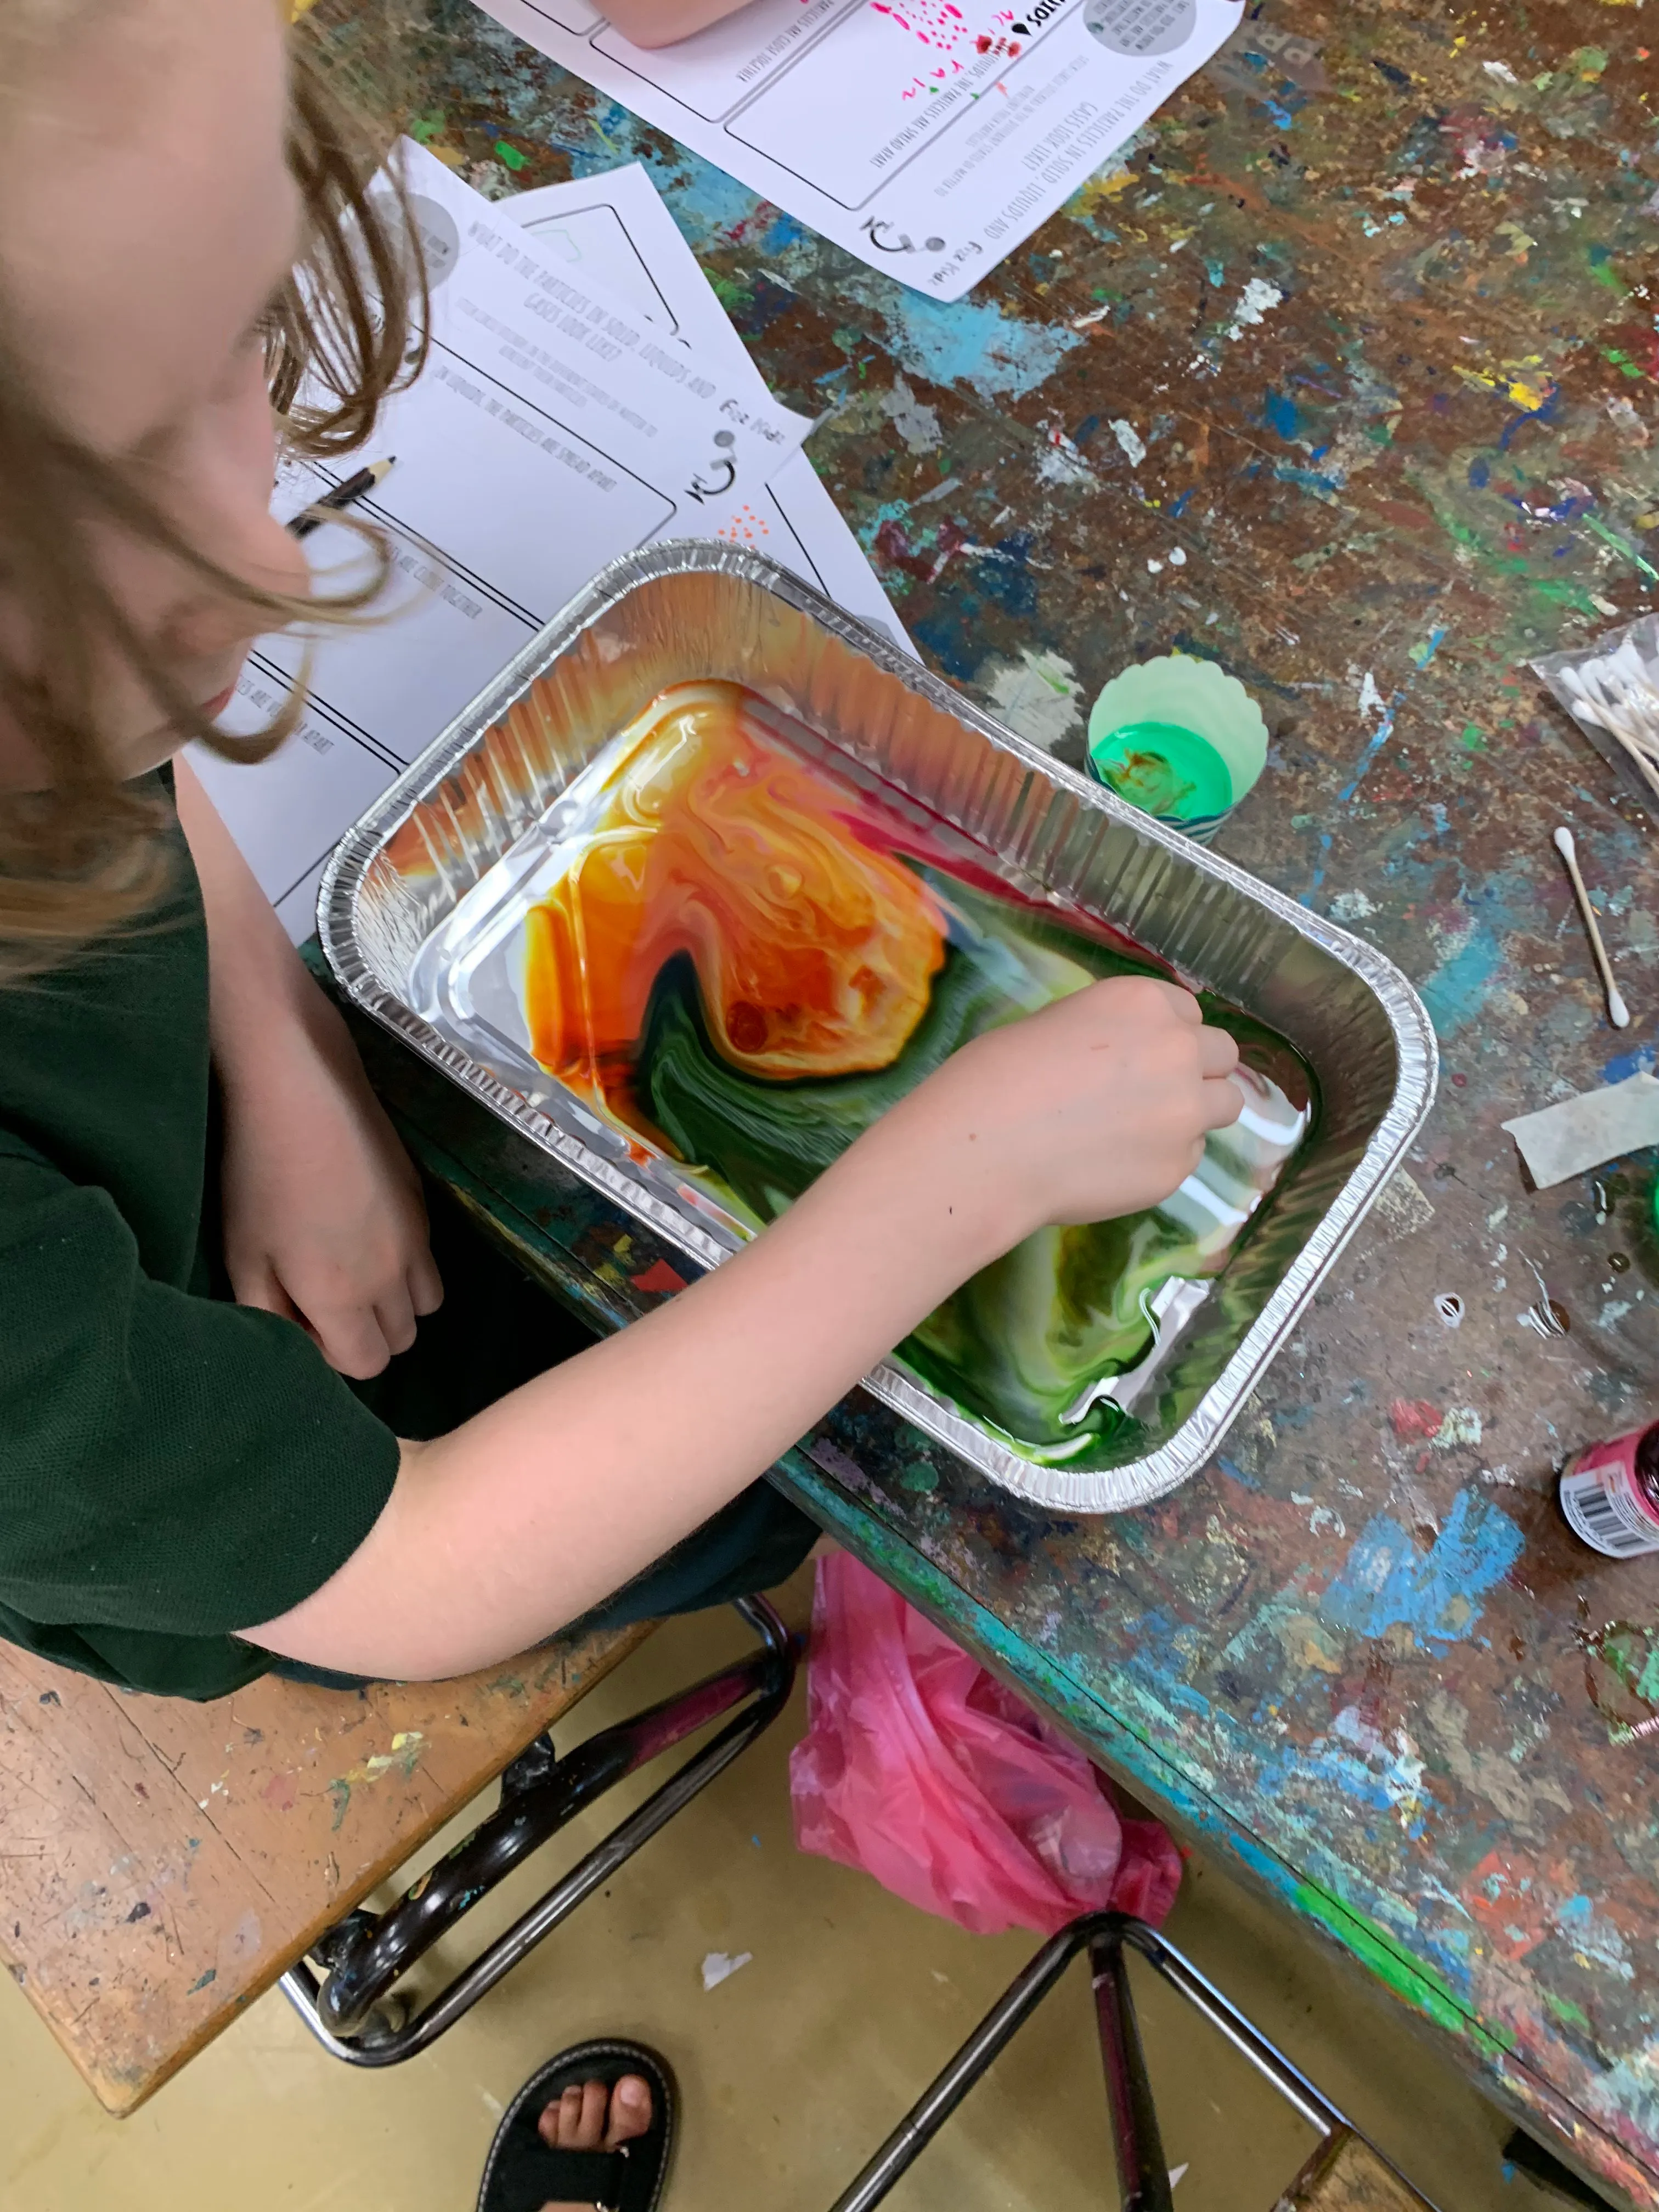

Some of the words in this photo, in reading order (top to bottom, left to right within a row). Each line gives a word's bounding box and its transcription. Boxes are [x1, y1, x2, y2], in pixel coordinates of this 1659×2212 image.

[783, 24, 804, 40] ARE
[764, 34, 792, 57] CLOSE
[734, 52, 773, 84] TOGETHER
[1142, 59, 1175, 83] WHAT
[953, 76, 974, 92] THE
[1128, 80, 1153, 96] DO
[922, 87, 962, 120] PARTICLES
[1063, 100, 1098, 129] GASES
[1114, 93, 1140, 110] THE
[910, 115, 930, 131] ARE
[1075, 107, 1125, 148] PARTICLES
[887, 125, 920, 151] SPREAD
[1042, 124, 1074, 149] LOOK
[868, 146, 896, 169] APART
[1020, 144, 1053, 170] LIKE?
[1063, 144, 1086, 159] IN
[998, 182, 1046, 221] LIQUIDS
[982, 219, 1010, 238] AND
[464, 219, 504, 252] WHAT
[494, 241, 522, 266] DO
[512, 254, 540, 279] THE
[532, 268, 592, 315] PARTICLES
[584, 304, 610, 327] IN
[636, 340, 693, 386] LIQUIDS
[684, 373, 719, 402] AND
[522, 290, 564, 325] GASES
[556, 313, 592, 343] LOOK
[584, 332, 624, 364] LIKE?
[482, 398, 504, 417] THE
[496, 407, 545, 445] PARTICLES
[538, 435, 561, 455] ARE
[554, 445, 592, 476] SPREAD
[585, 466, 618, 494] APART
[397, 553, 419, 574] ARE
[438, 583, 484, 621] TOGETHER
[300, 726, 335, 757] APART
